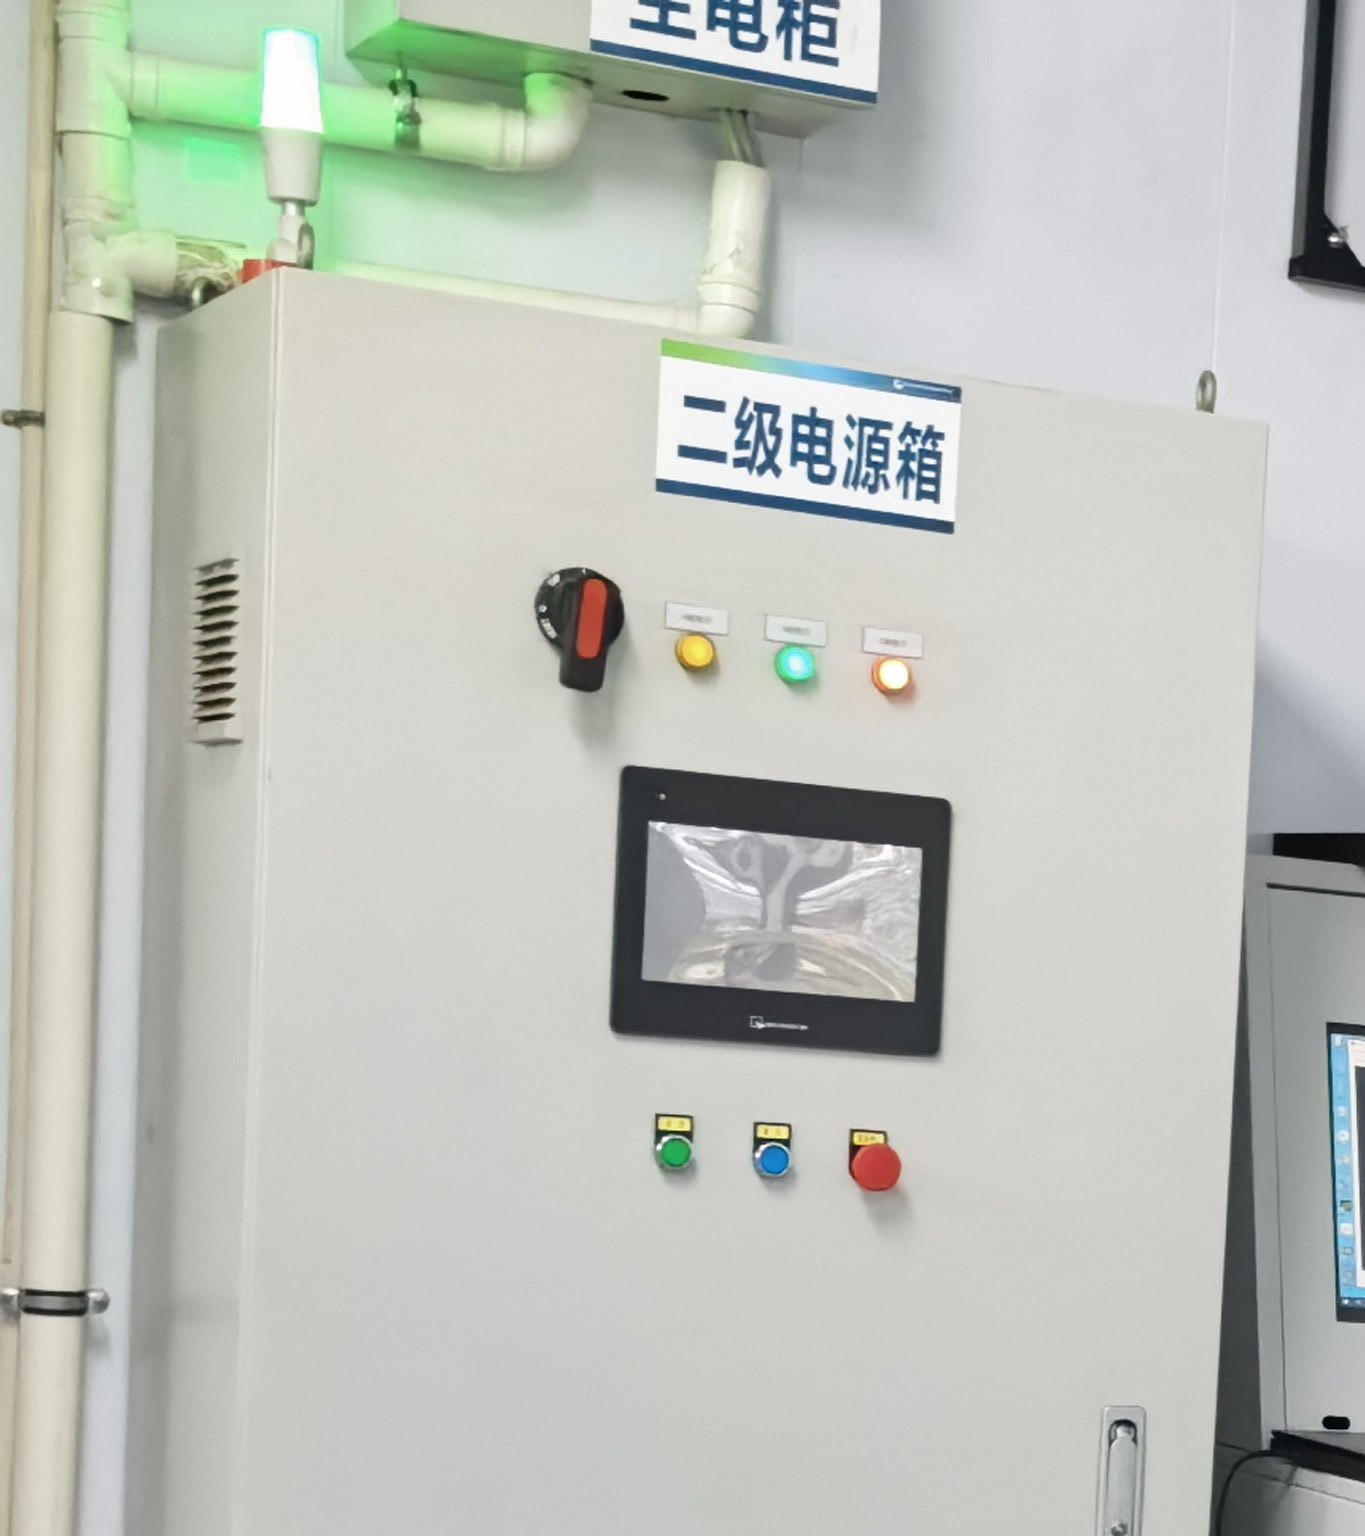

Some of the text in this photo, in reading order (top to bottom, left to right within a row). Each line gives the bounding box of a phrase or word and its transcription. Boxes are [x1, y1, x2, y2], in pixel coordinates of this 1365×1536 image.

[676, 395, 946, 505] 二级电源箱
